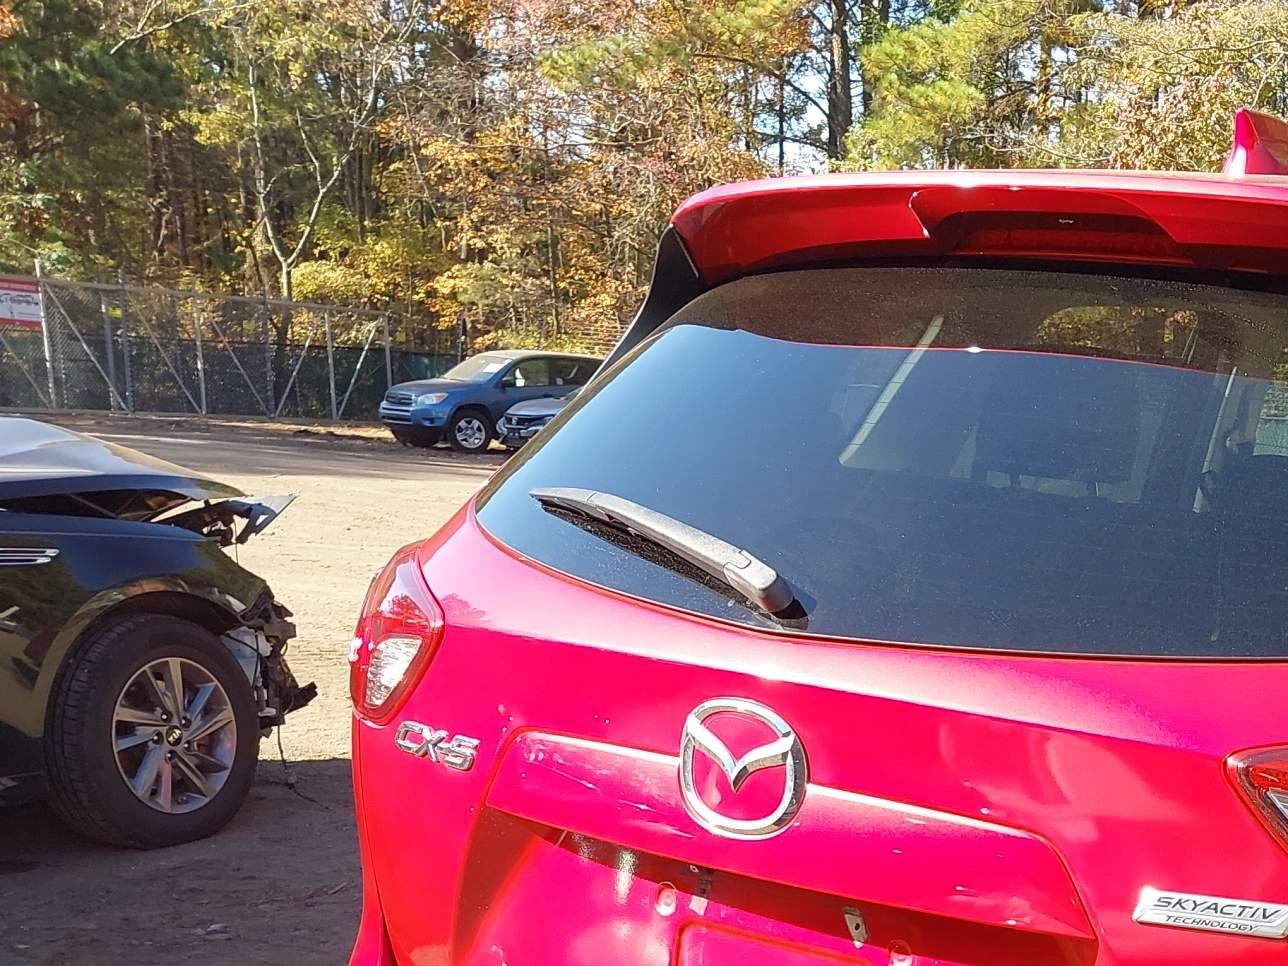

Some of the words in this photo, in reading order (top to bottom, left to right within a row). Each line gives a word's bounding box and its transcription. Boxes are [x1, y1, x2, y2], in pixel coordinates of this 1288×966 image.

[395, 720, 481, 772] CX-5
[1153, 896, 1281, 920] SKYACTIV
[1165, 915, 1260, 932] TECHNOLOGY
